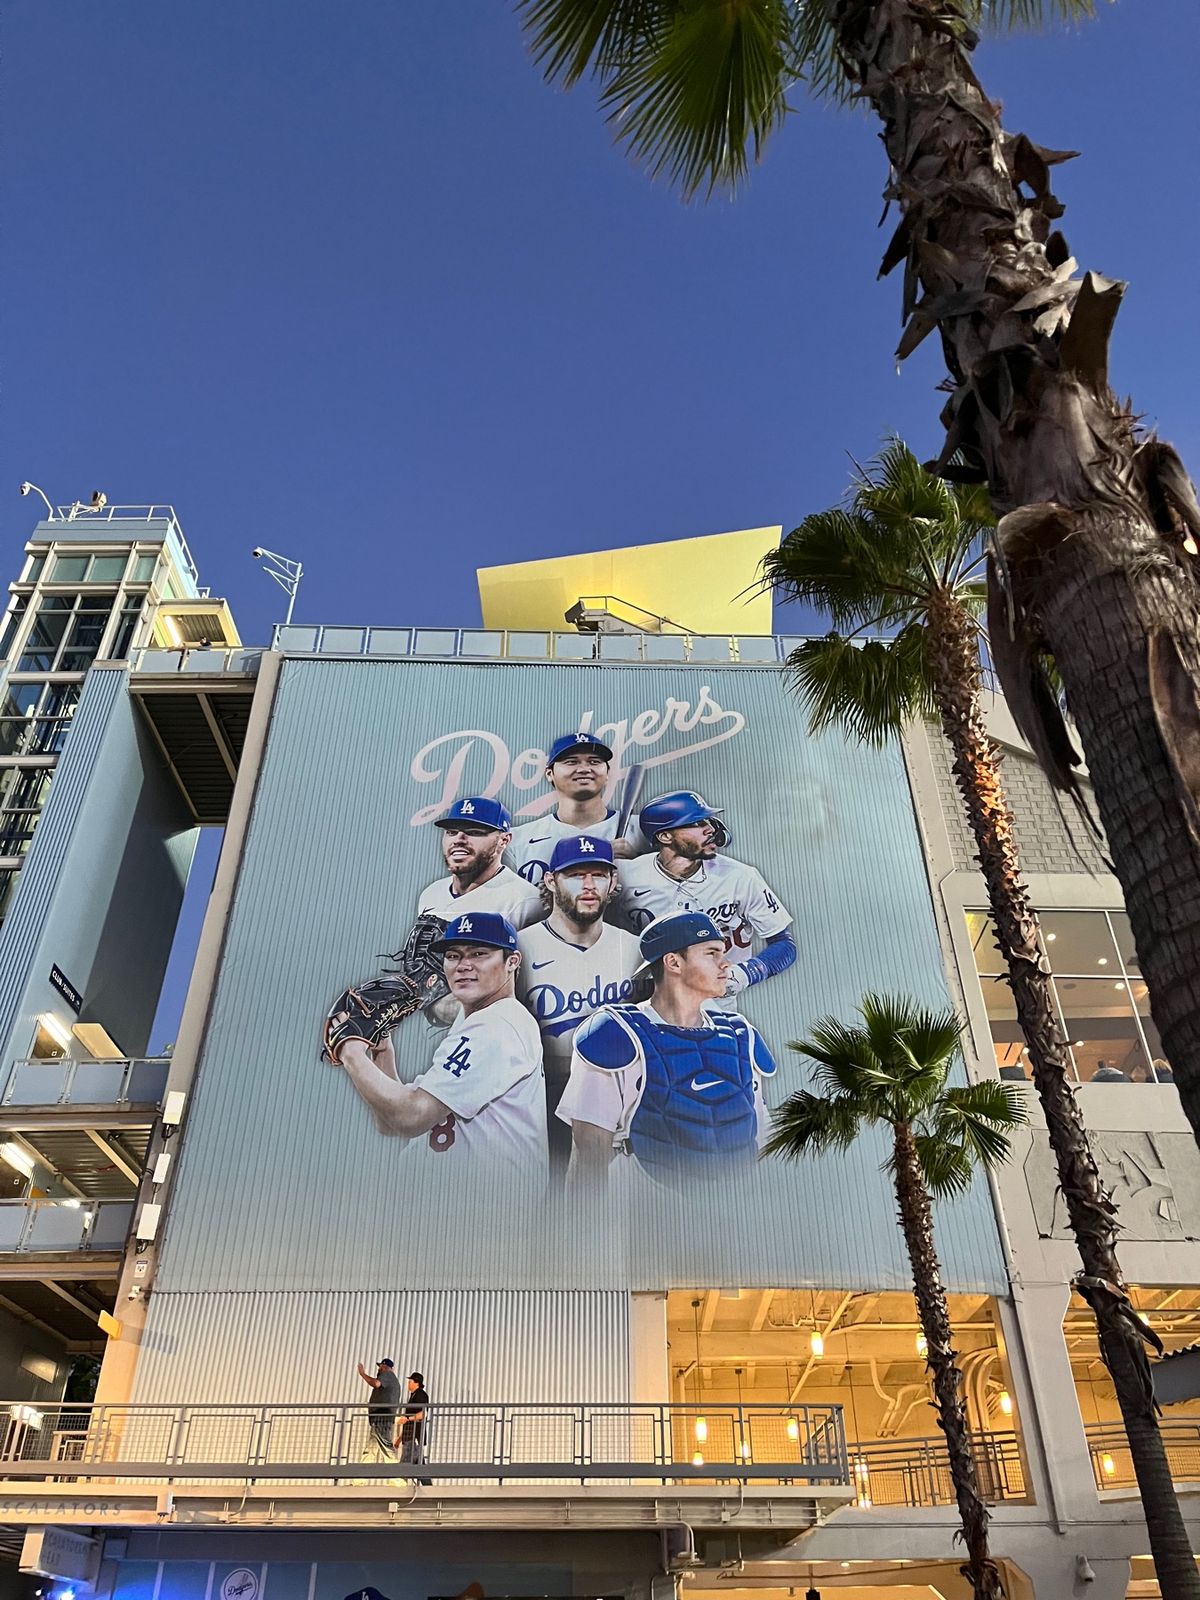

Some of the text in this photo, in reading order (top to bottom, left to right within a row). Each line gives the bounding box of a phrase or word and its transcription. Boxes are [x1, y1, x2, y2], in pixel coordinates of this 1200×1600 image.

[574, 732, 590, 744] LA
[460, 799, 476, 815] LA
[578, 837, 596, 853] LA
[763, 889, 780, 914] LA
[457, 915, 473, 933] LA
[526, 975, 635, 1020] Dodge
[442, 1036, 472, 1078] LA
